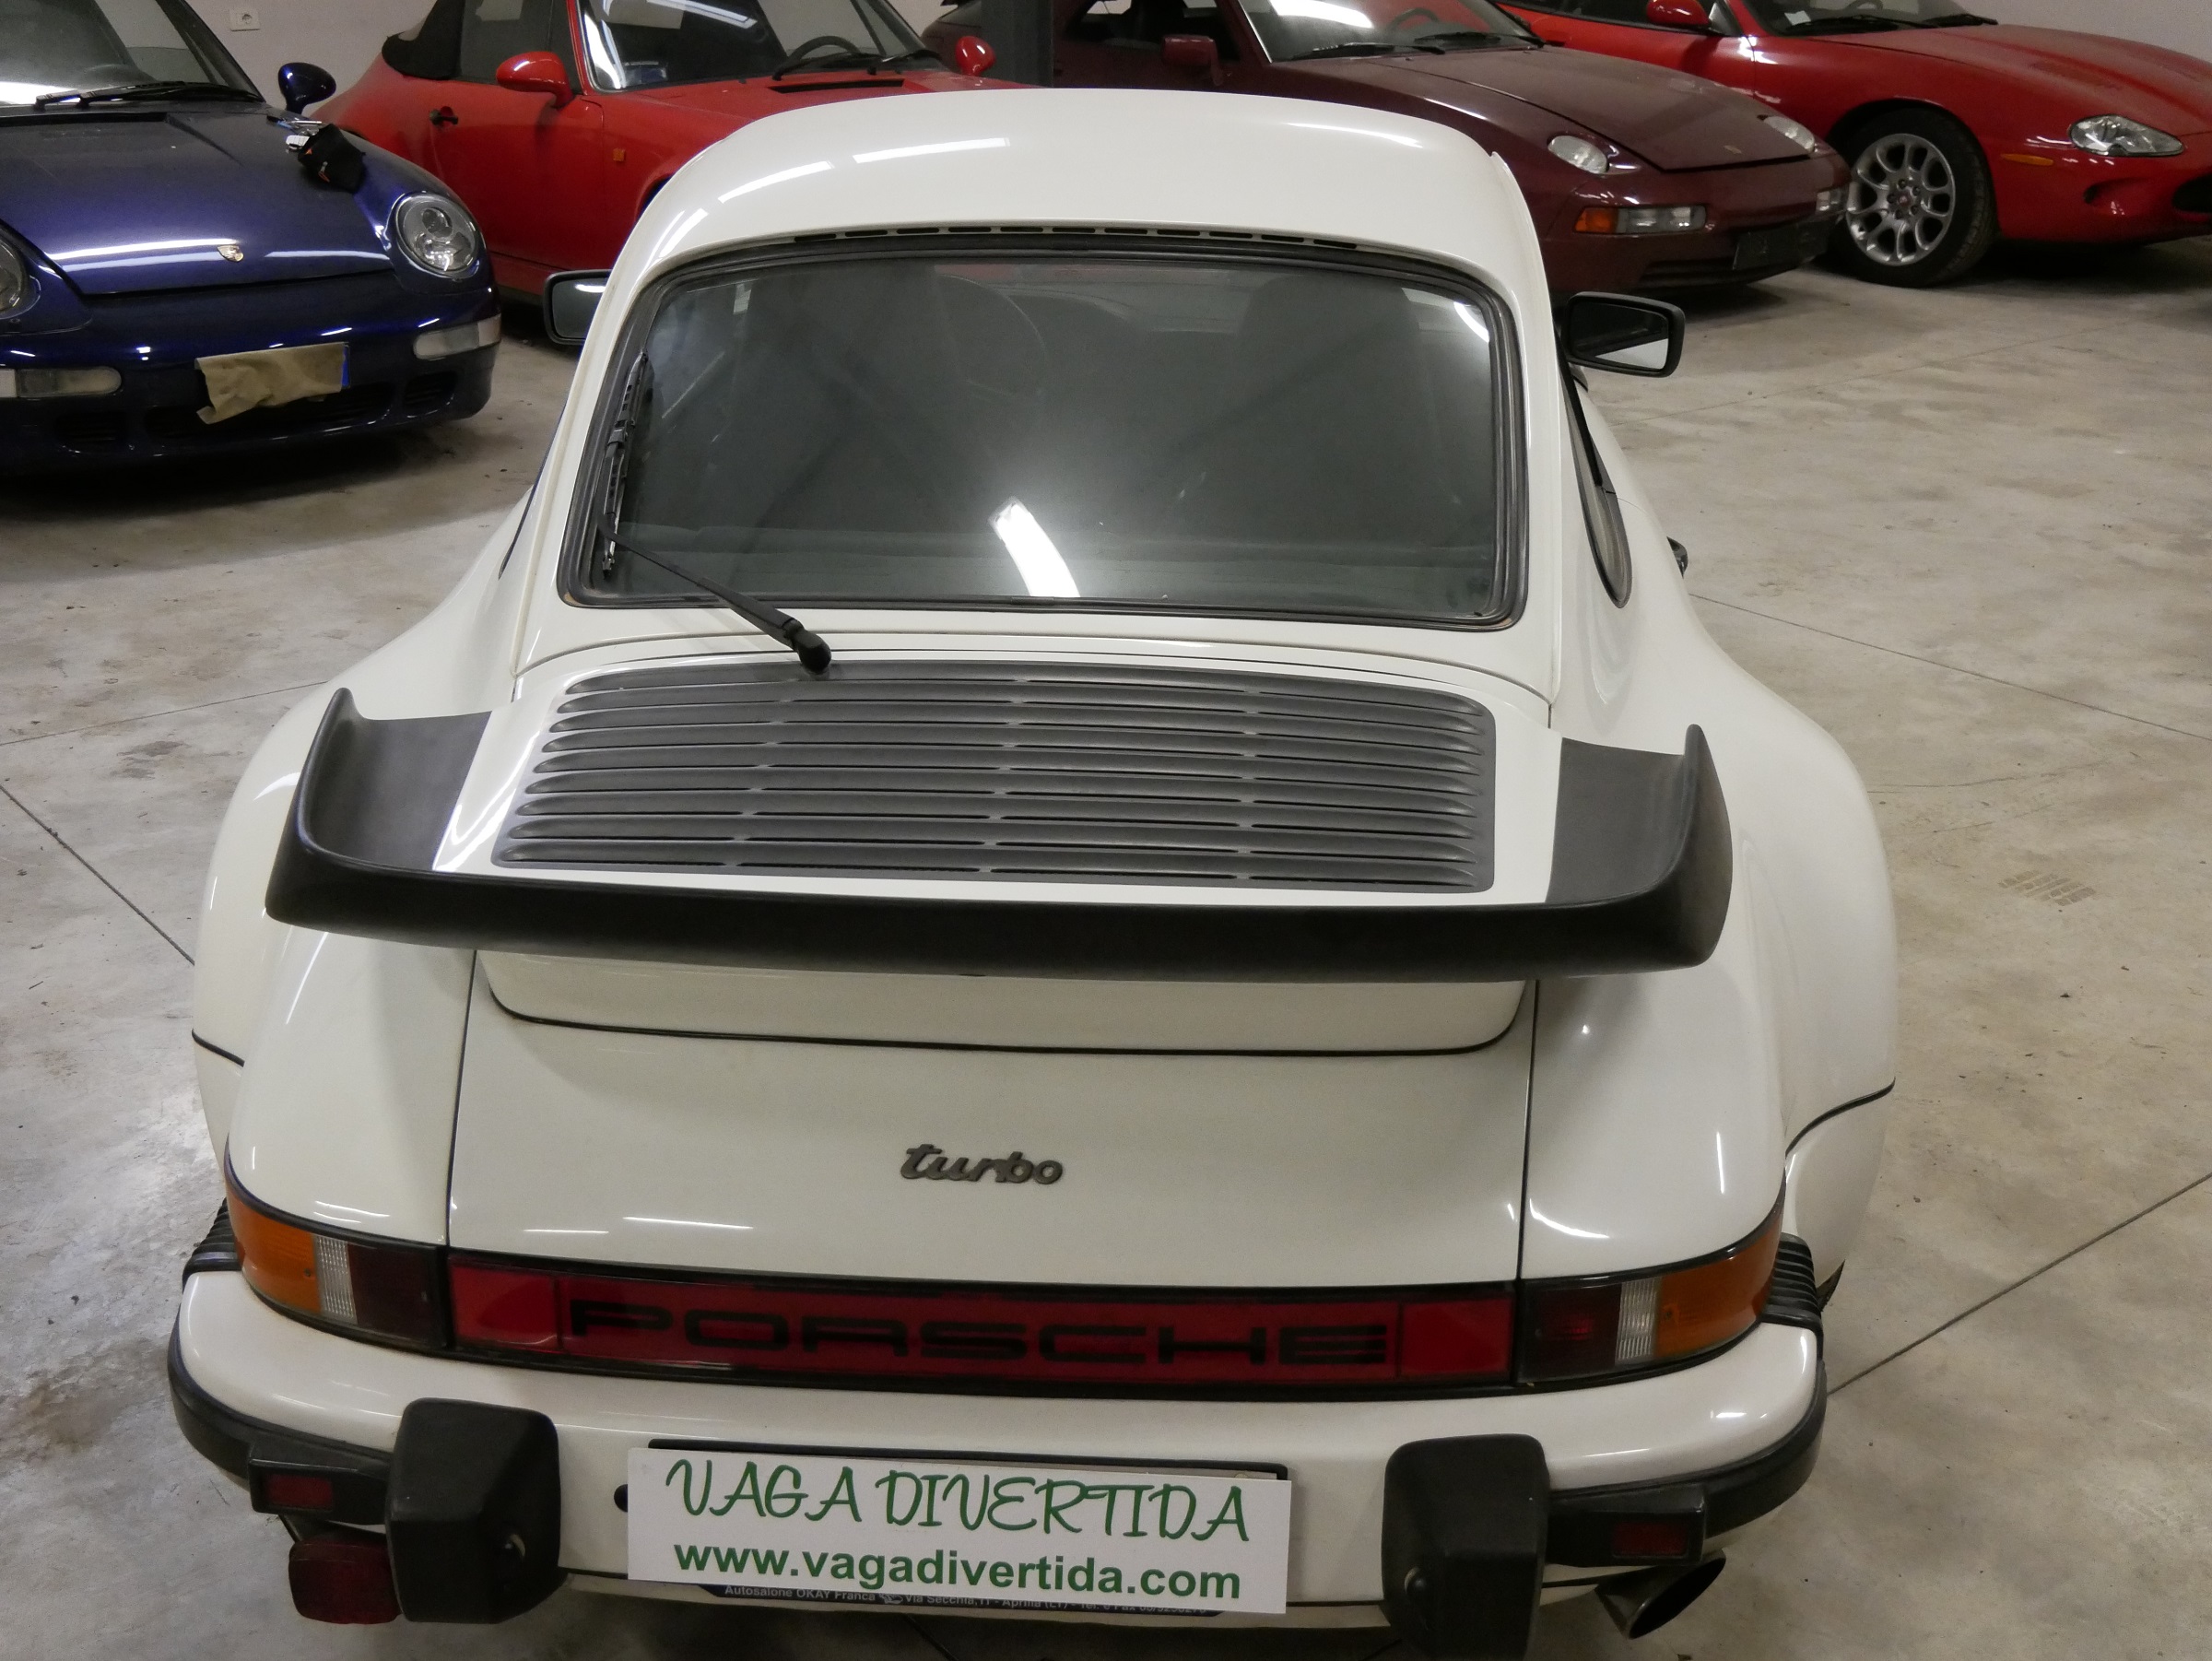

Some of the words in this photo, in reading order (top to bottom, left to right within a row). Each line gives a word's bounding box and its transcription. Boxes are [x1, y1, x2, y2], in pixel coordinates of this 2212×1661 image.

[900, 1143, 1064, 1185] turbo
[569, 1299, 1388, 1366] PORSCHE
[665, 1458, 863, 1523] VAGA
[875, 1469, 1250, 1542] DIVERTIDA
[673, 1543, 1241, 1599] www.vagadivertida.com
[724, 1584, 794, 1597] Autosalone
[795, 1588, 830, 1599] OKAY
[834, 1591, 876, 1602] Franca
